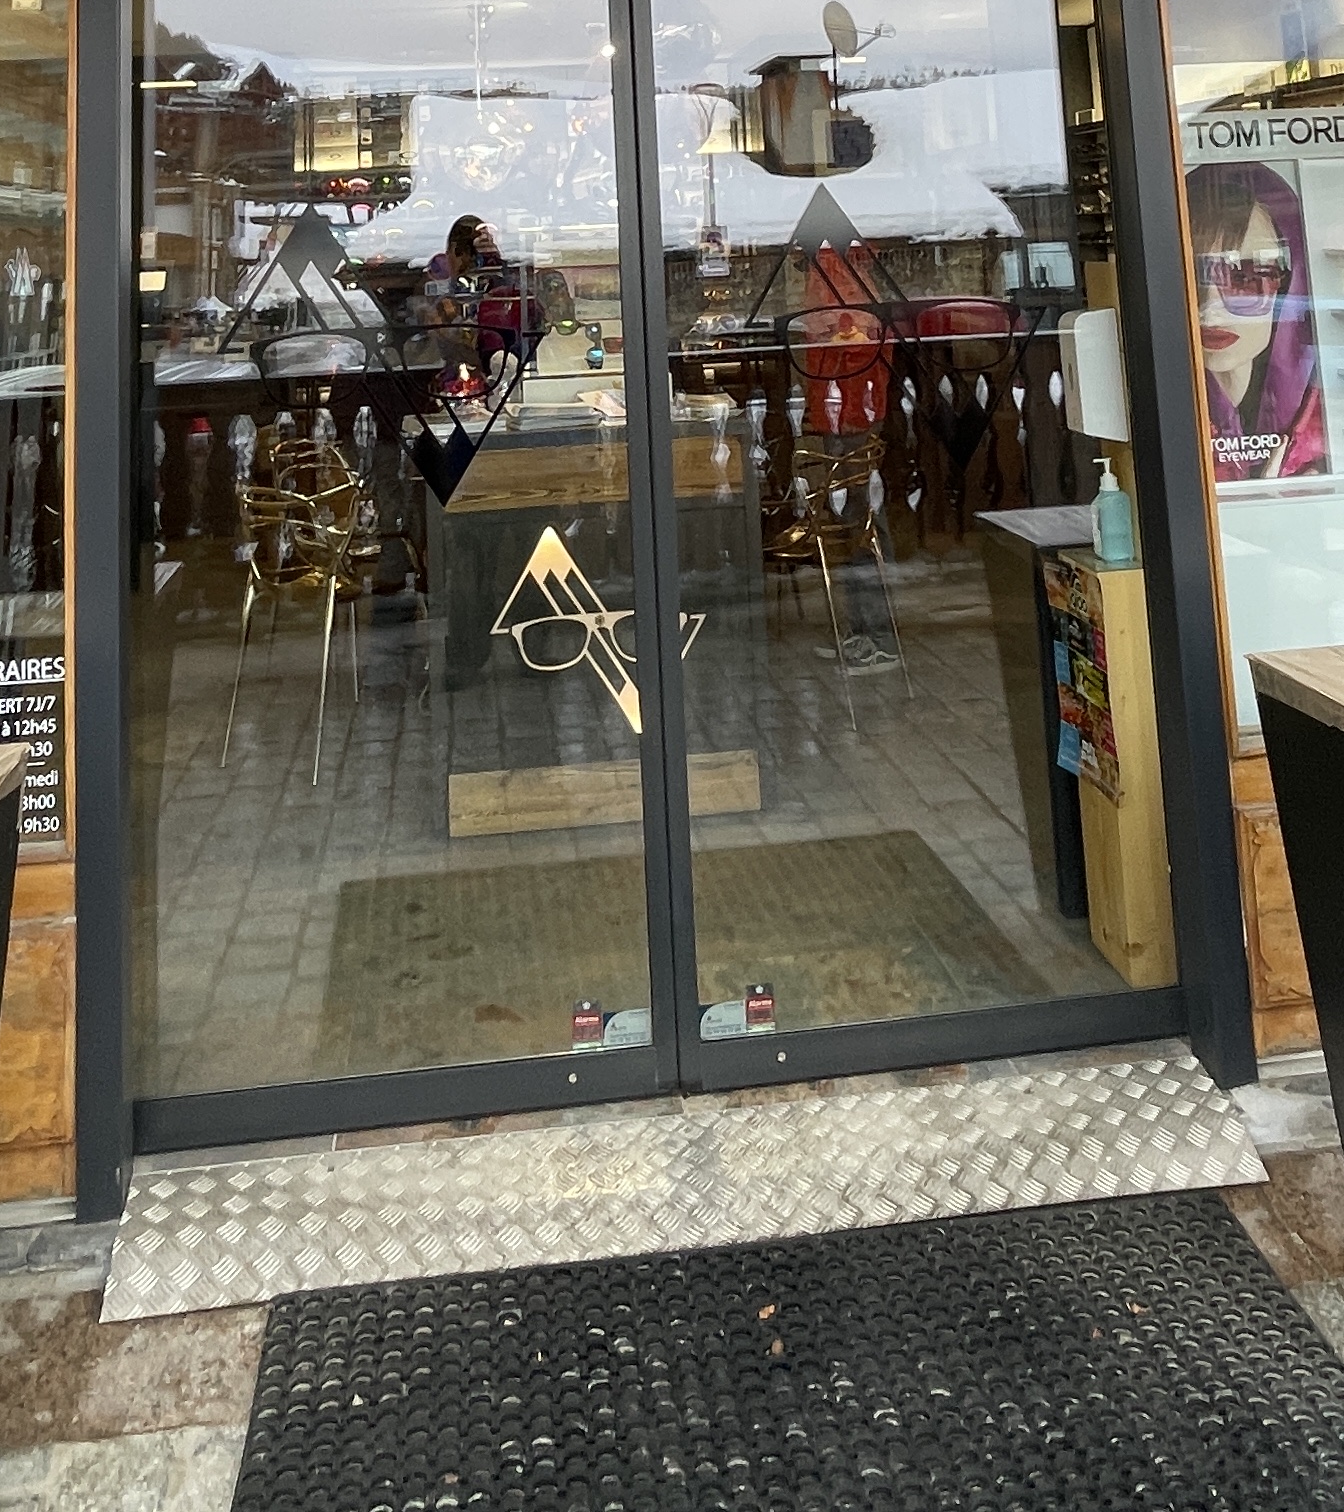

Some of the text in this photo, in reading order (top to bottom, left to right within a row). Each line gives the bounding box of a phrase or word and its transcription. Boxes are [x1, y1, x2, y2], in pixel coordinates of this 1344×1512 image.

[1187, 119, 1262, 150] TOM
[1240, 433, 1281, 450] FORD
[1218, 449, 1271, 463] EYEWEAR
[1, 721, 11, 737] à
[13, 718, 57, 737] 12h45
[22, 793, 56, 811] 3h00
